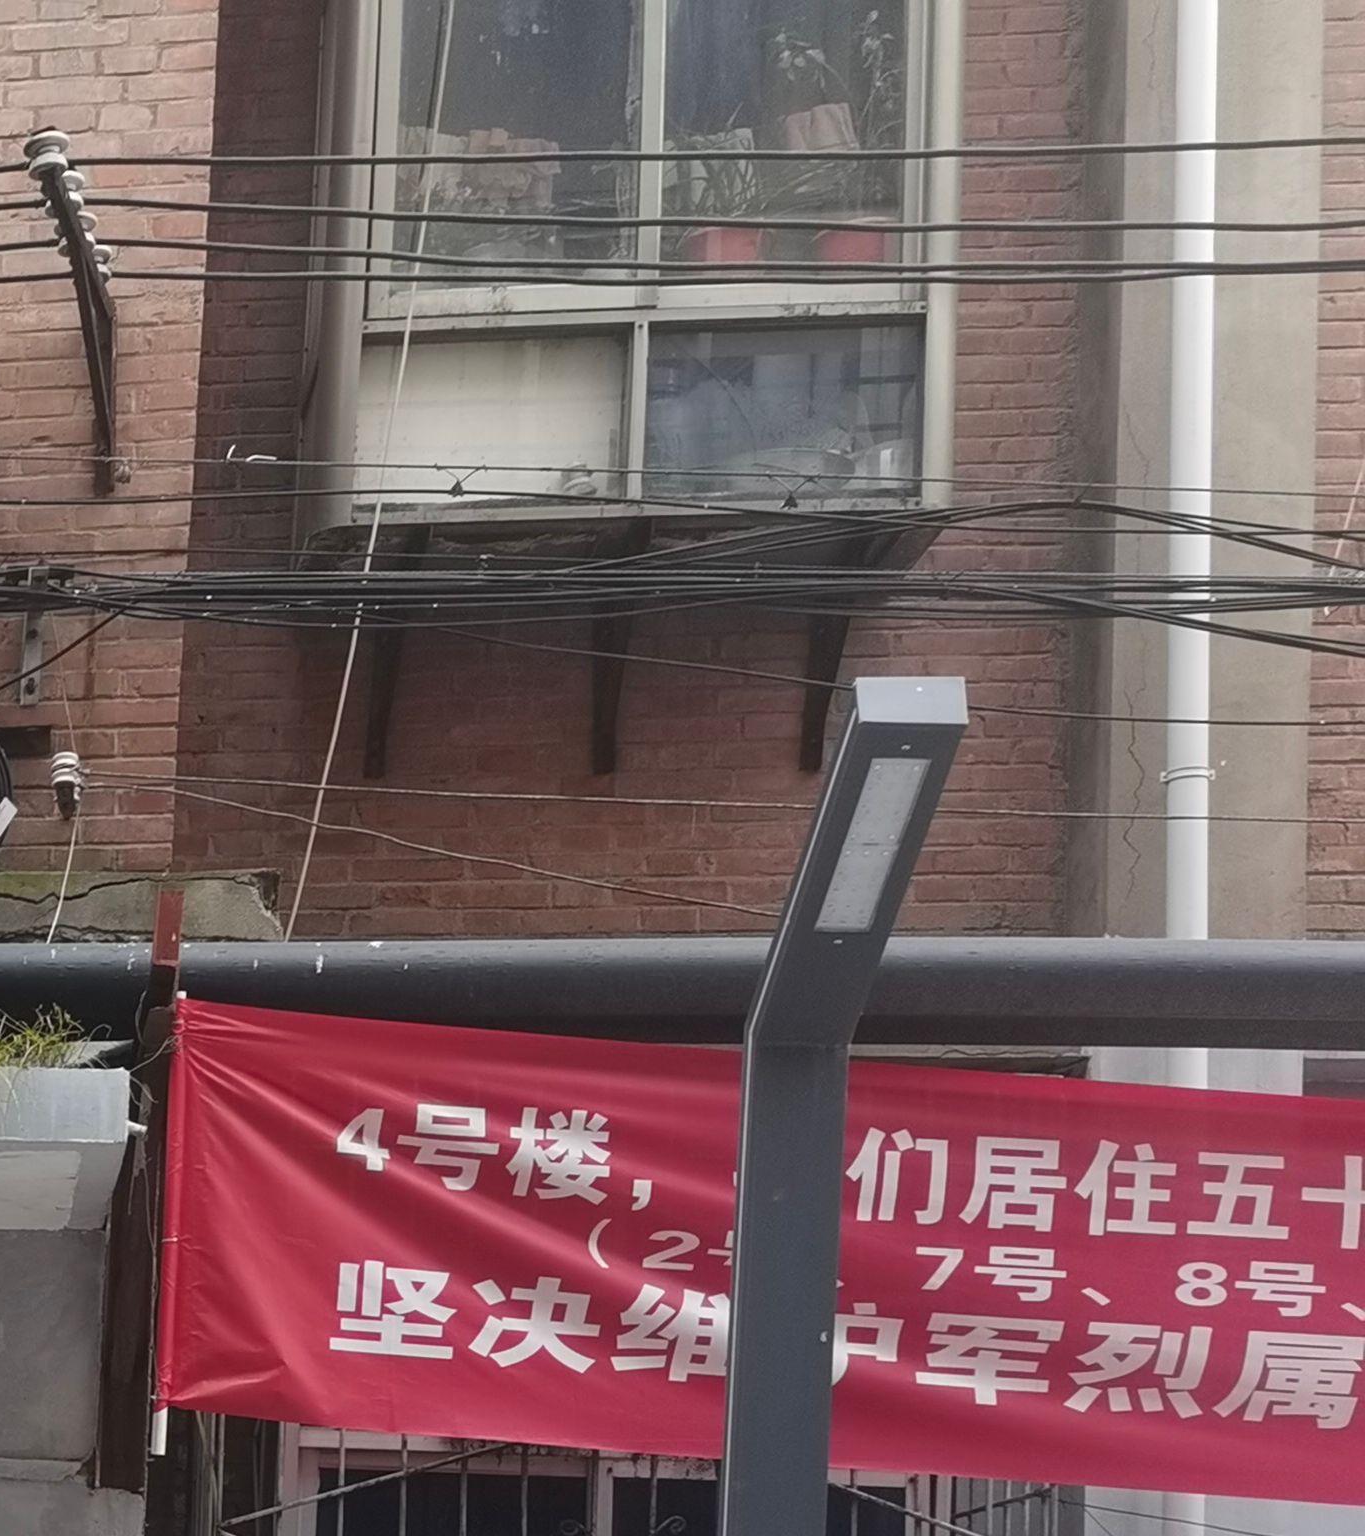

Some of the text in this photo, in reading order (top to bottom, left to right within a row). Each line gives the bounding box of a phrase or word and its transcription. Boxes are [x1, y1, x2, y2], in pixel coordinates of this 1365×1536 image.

[336, 1103, 1365, 1250] 4号楼，们居住五十
